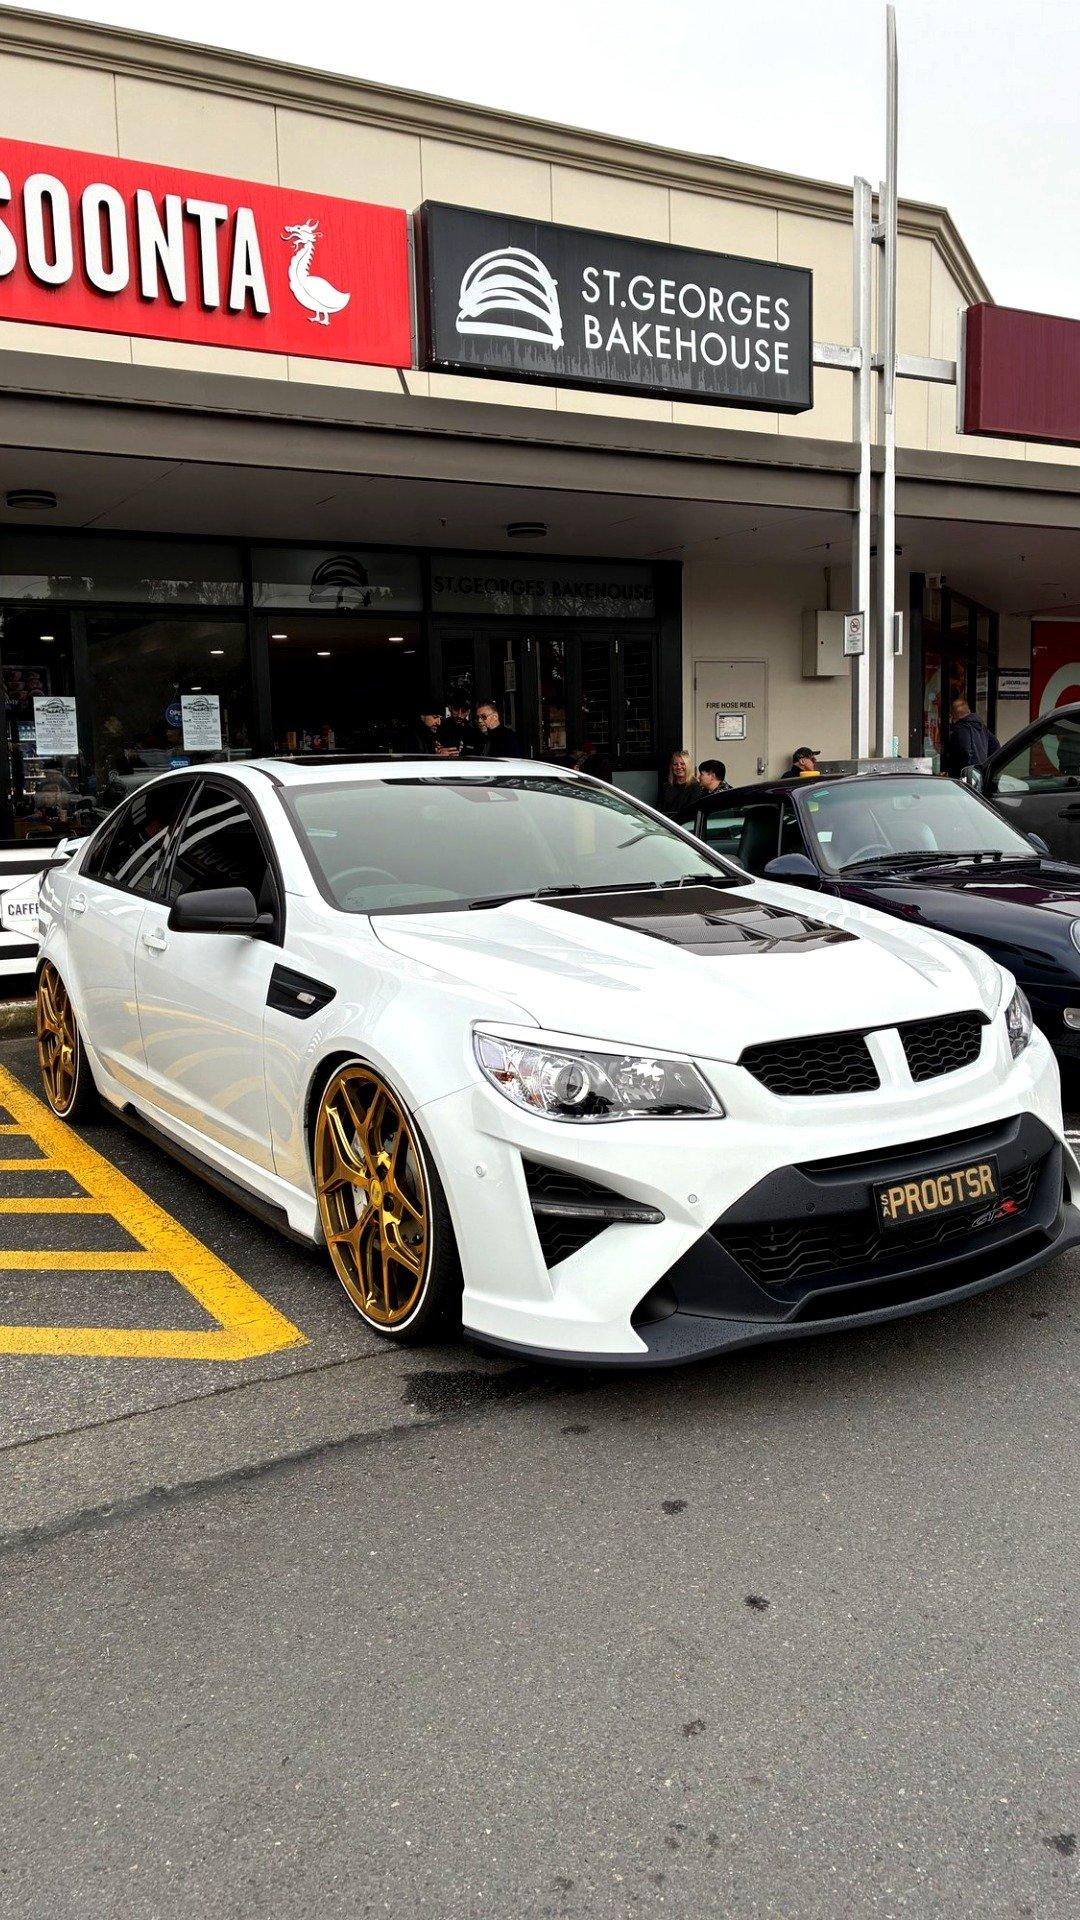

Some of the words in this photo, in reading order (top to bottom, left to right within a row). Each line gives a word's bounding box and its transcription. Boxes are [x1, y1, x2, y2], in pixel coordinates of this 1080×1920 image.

[581, 267, 790, 331] ST.GEORGES
[584, 314, 789, 375] BAKEHOUSE
[552, 580, 656, 601] BAKEHOUSE
[888, 1165, 995, 1219] PROGTSR
